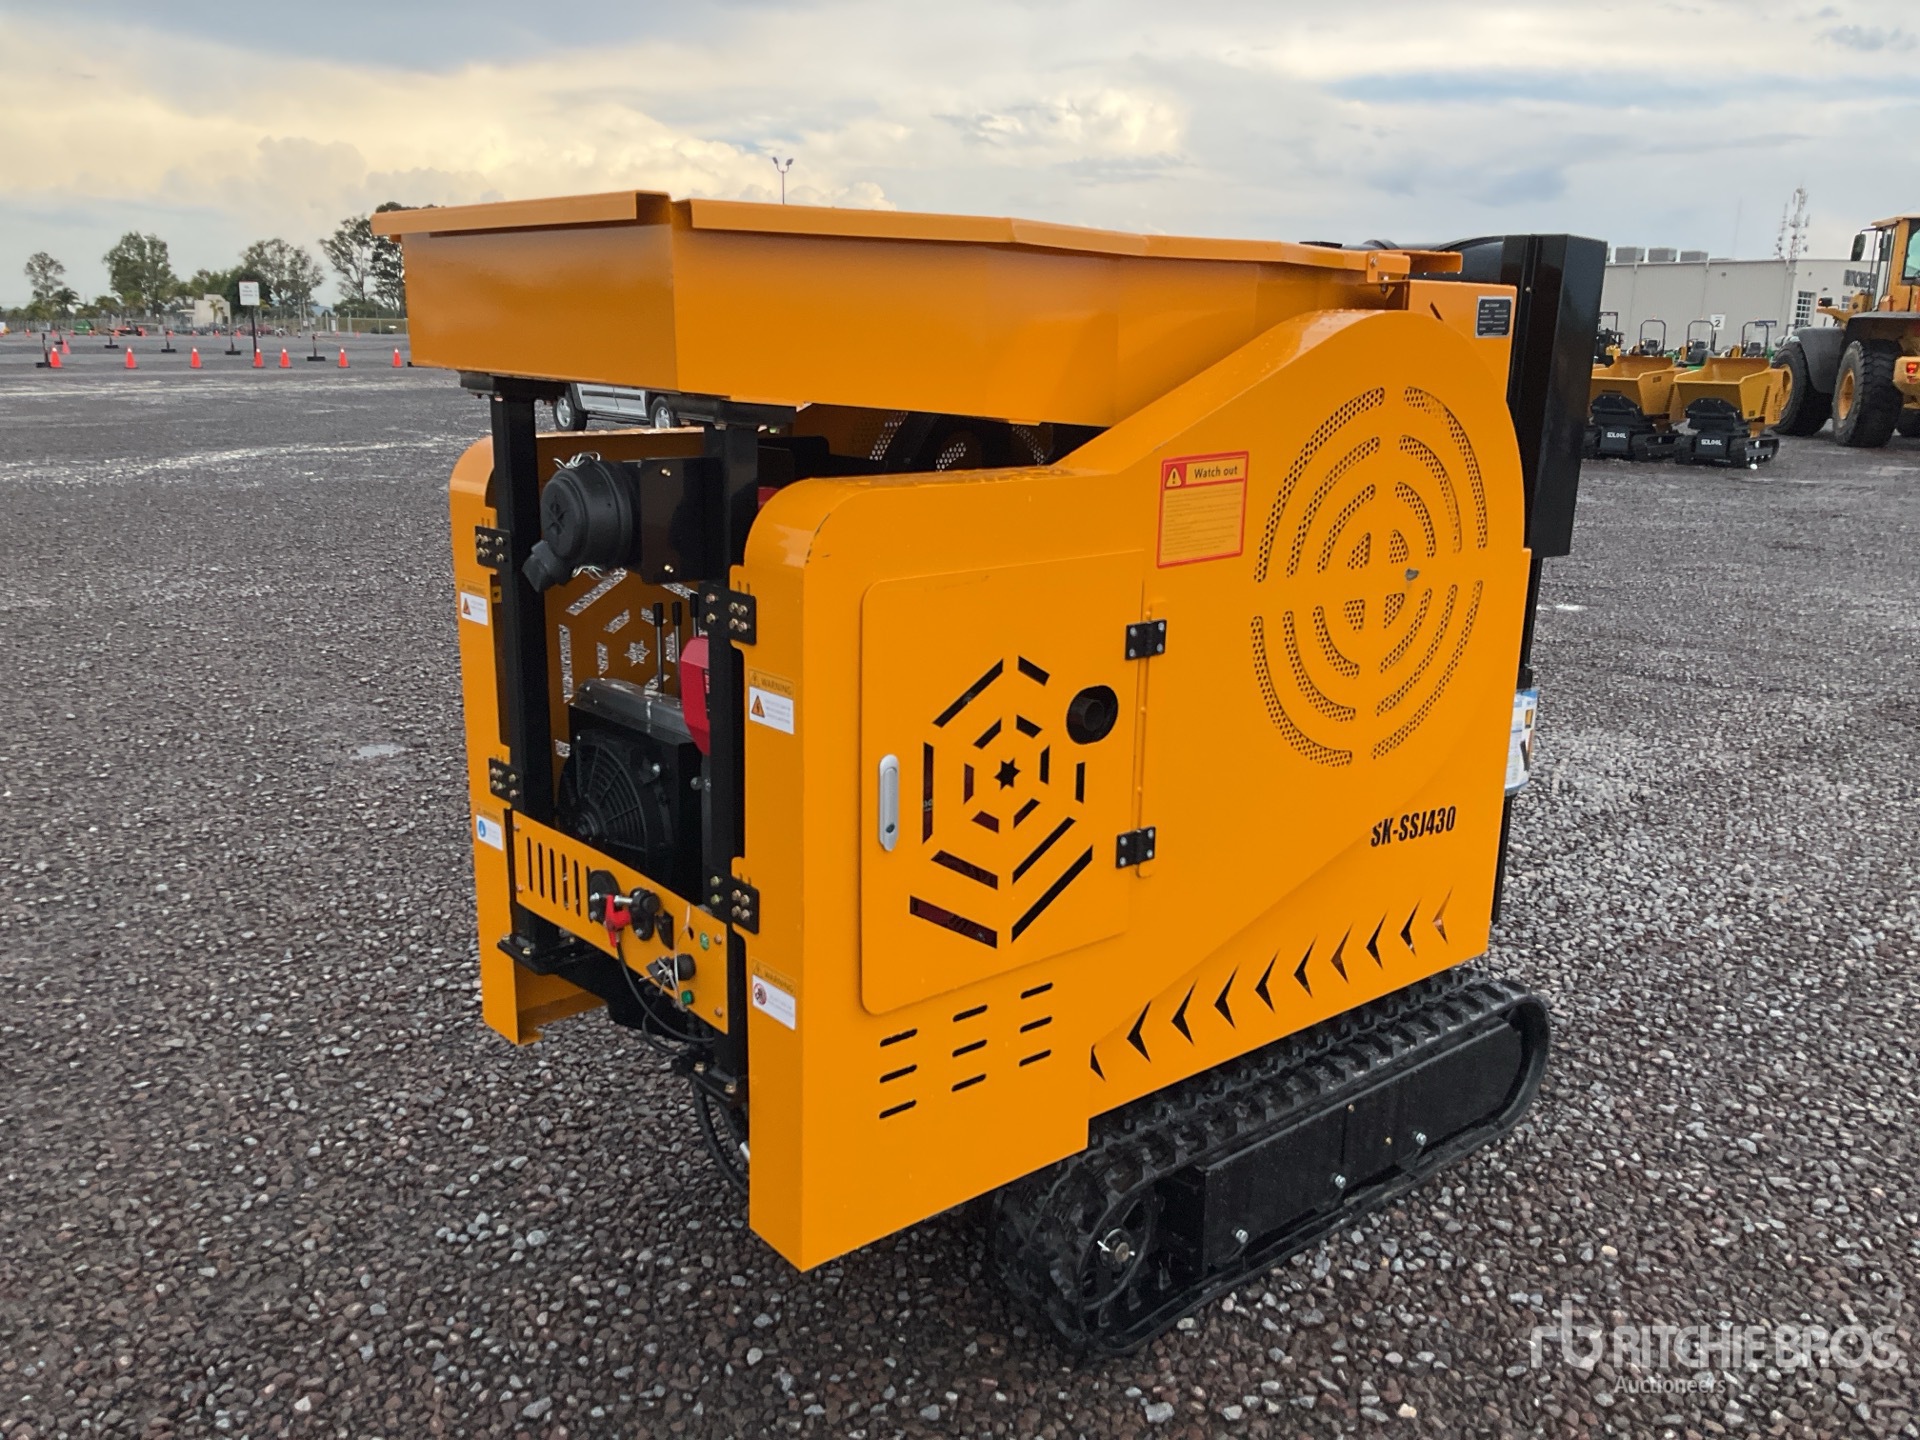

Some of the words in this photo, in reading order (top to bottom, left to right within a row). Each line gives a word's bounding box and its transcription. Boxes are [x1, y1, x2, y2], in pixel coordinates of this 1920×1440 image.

[1714, 319, 1721, 328] 2
[1194, 466, 1221, 479] Watch
[1224, 466, 1238, 475] out
[1370, 805, 1457, 848] SK-SSJ430
